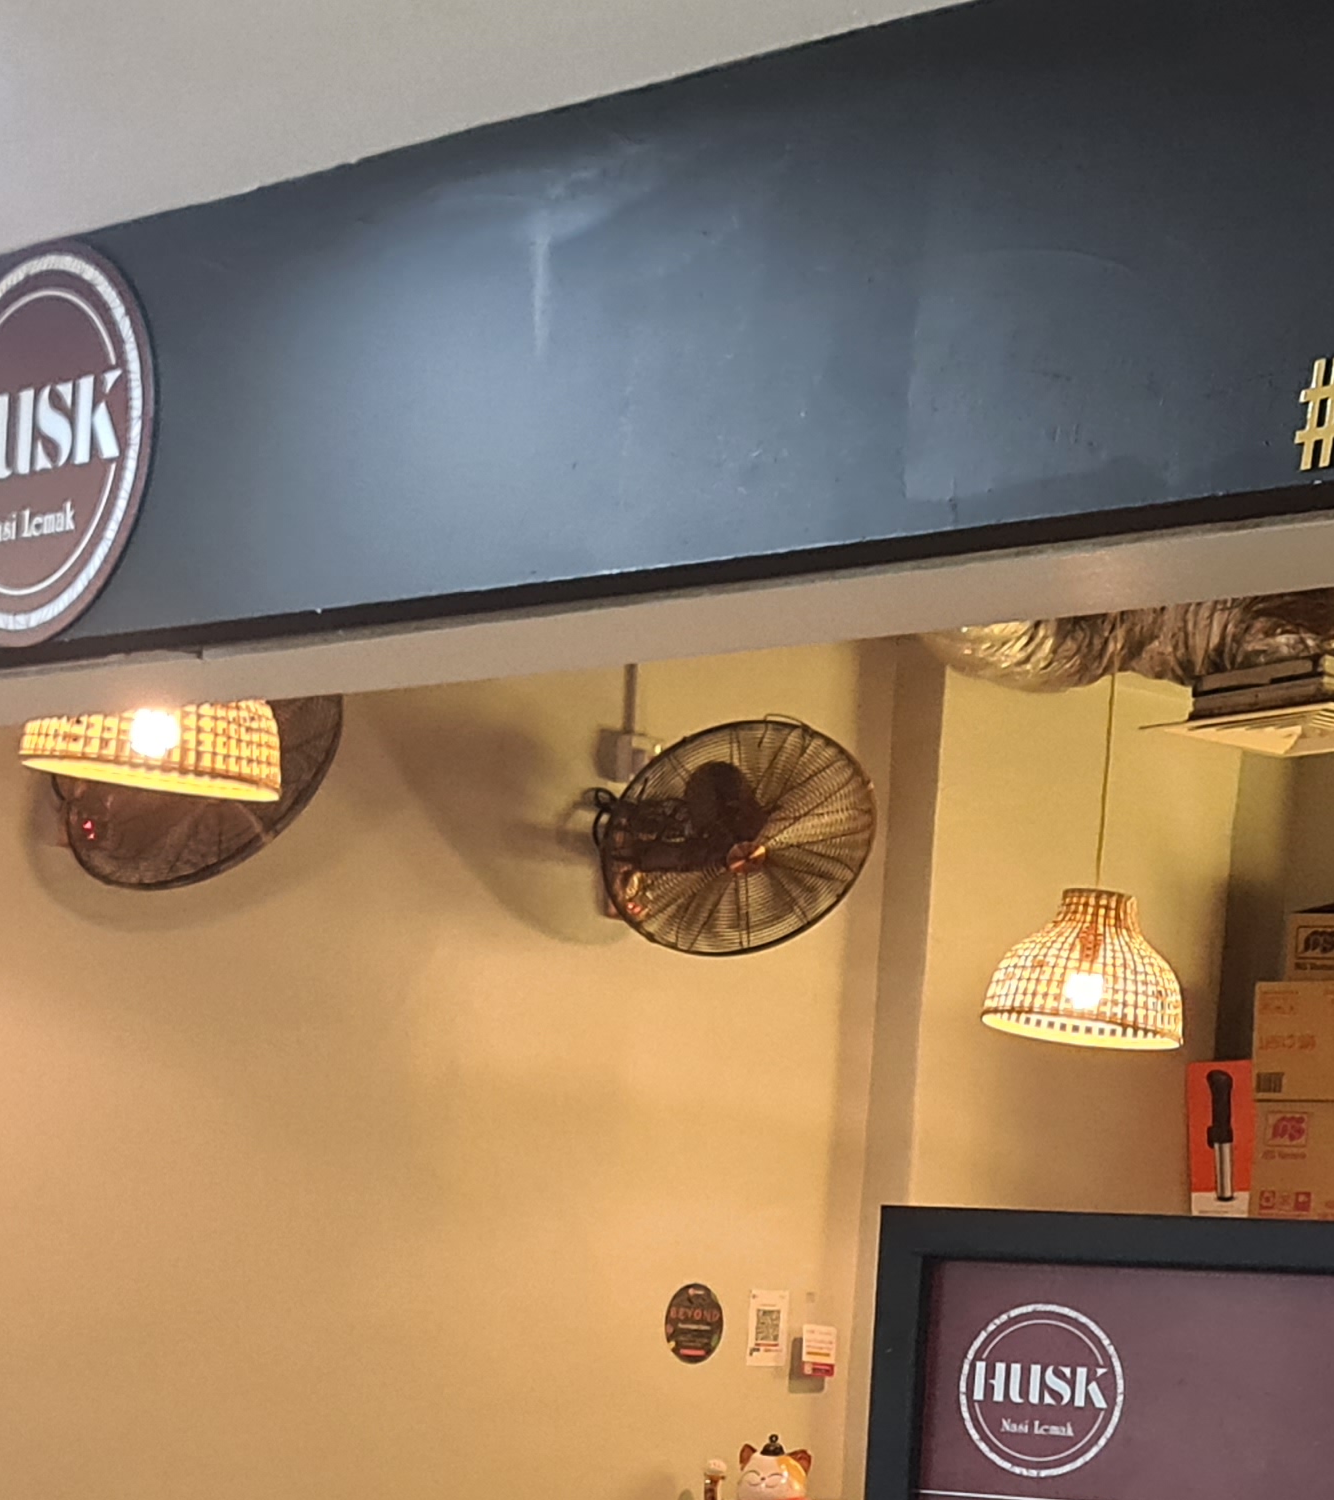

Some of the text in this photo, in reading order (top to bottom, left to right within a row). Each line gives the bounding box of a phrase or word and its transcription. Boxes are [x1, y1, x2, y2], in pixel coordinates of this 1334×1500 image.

[21, 499, 76, 538] Lemak
[973, 1361, 1108, 1408] HUSK
[1001, 1418, 1074, 1437] Nasi Lemak
